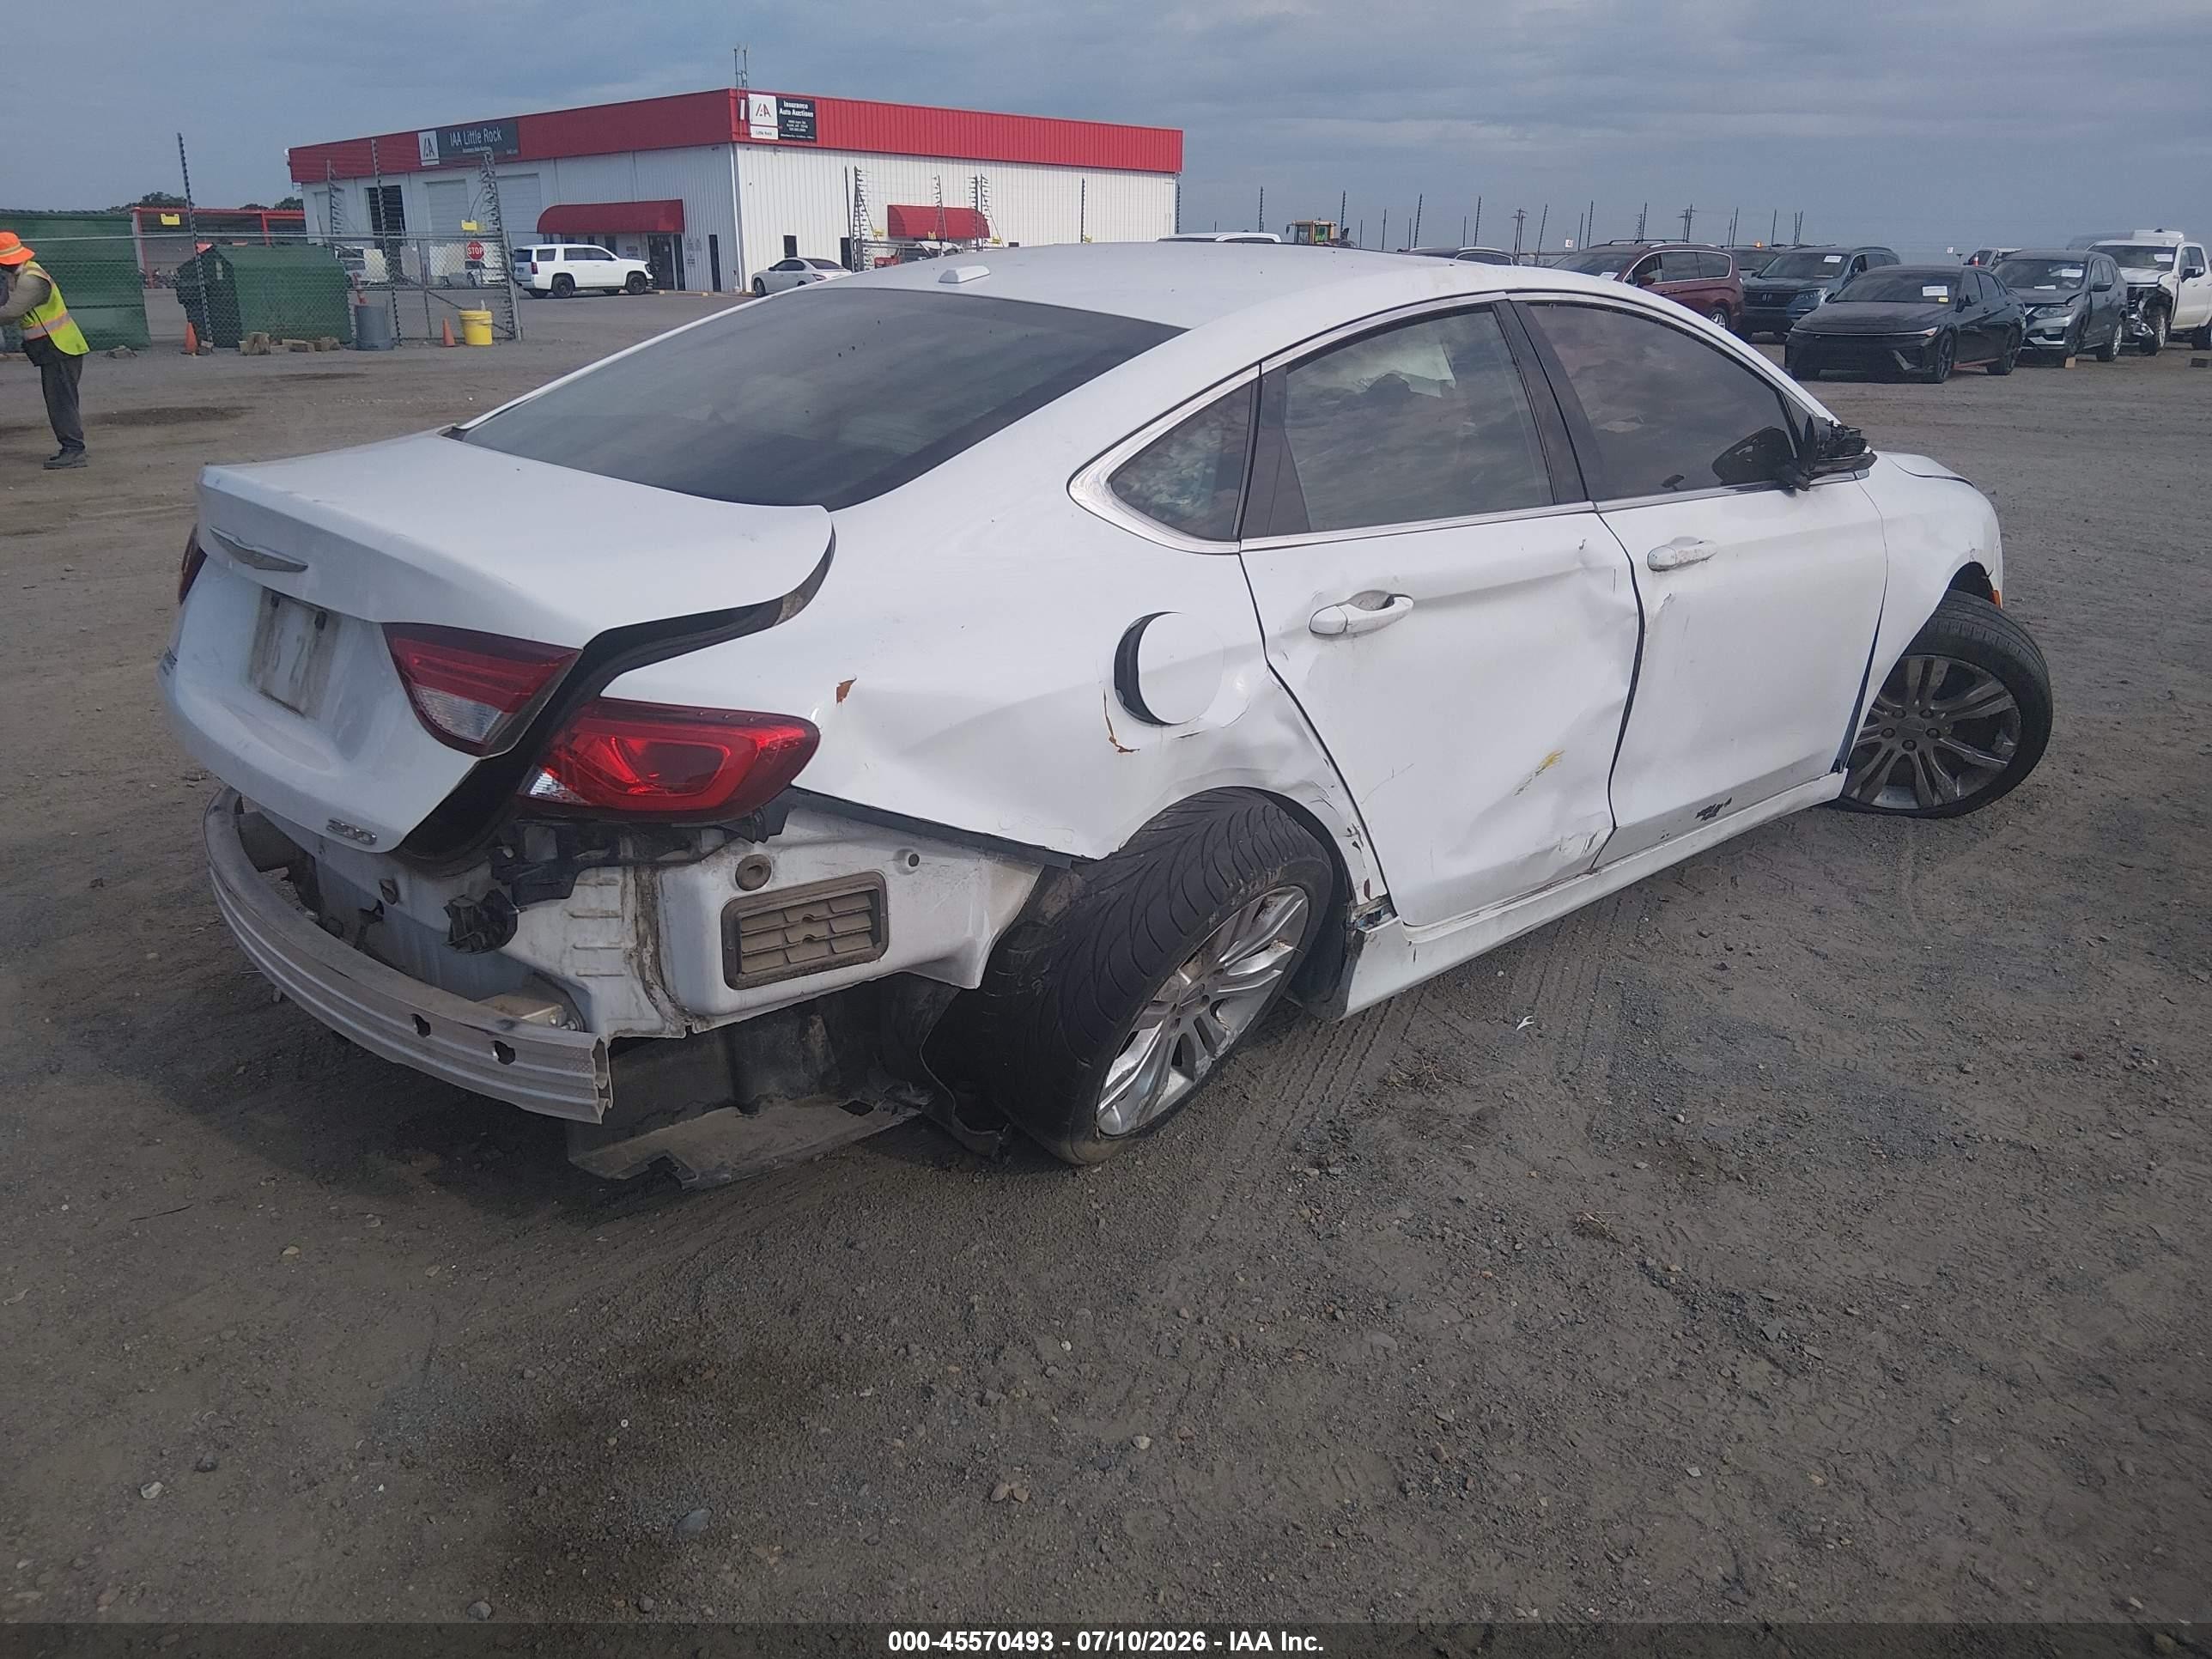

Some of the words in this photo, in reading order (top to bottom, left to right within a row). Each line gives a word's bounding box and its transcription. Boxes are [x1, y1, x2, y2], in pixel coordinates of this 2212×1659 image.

[792, 109, 813, 118] Auctions
[450, 132, 462, 147] IAA
[464, 130, 482, 145] Little
[483, 127, 501, 143] Rock
[326, 818, 377, 845] 200
